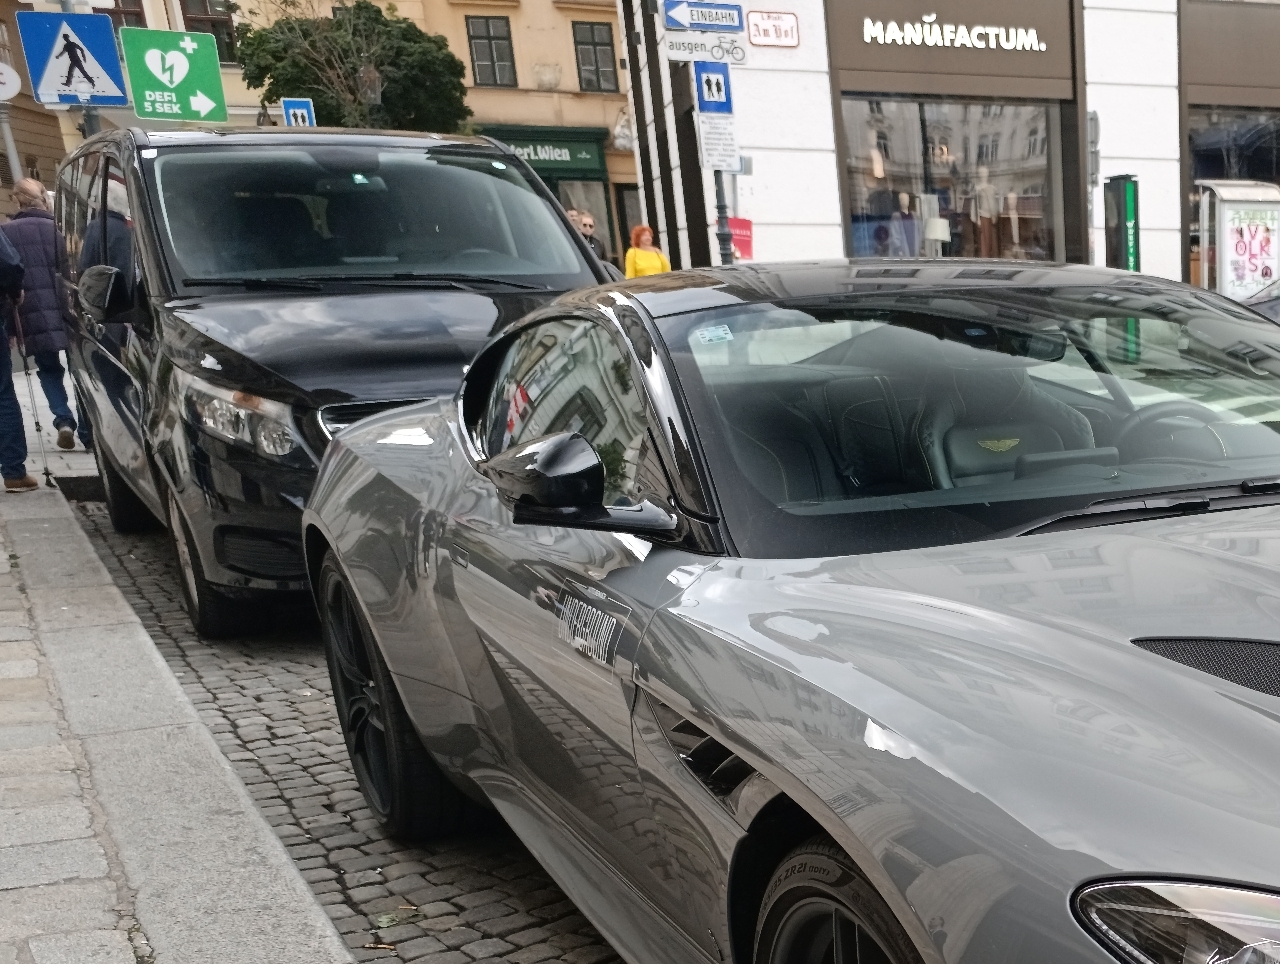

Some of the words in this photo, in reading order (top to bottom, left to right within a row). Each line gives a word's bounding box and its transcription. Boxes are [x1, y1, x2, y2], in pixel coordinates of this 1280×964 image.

[690, 10, 735, 24] EINBAHN
[145, 91, 177, 103] DEFI
[145, 103, 152, 112] 5
[156, 103, 182, 114] SEK
